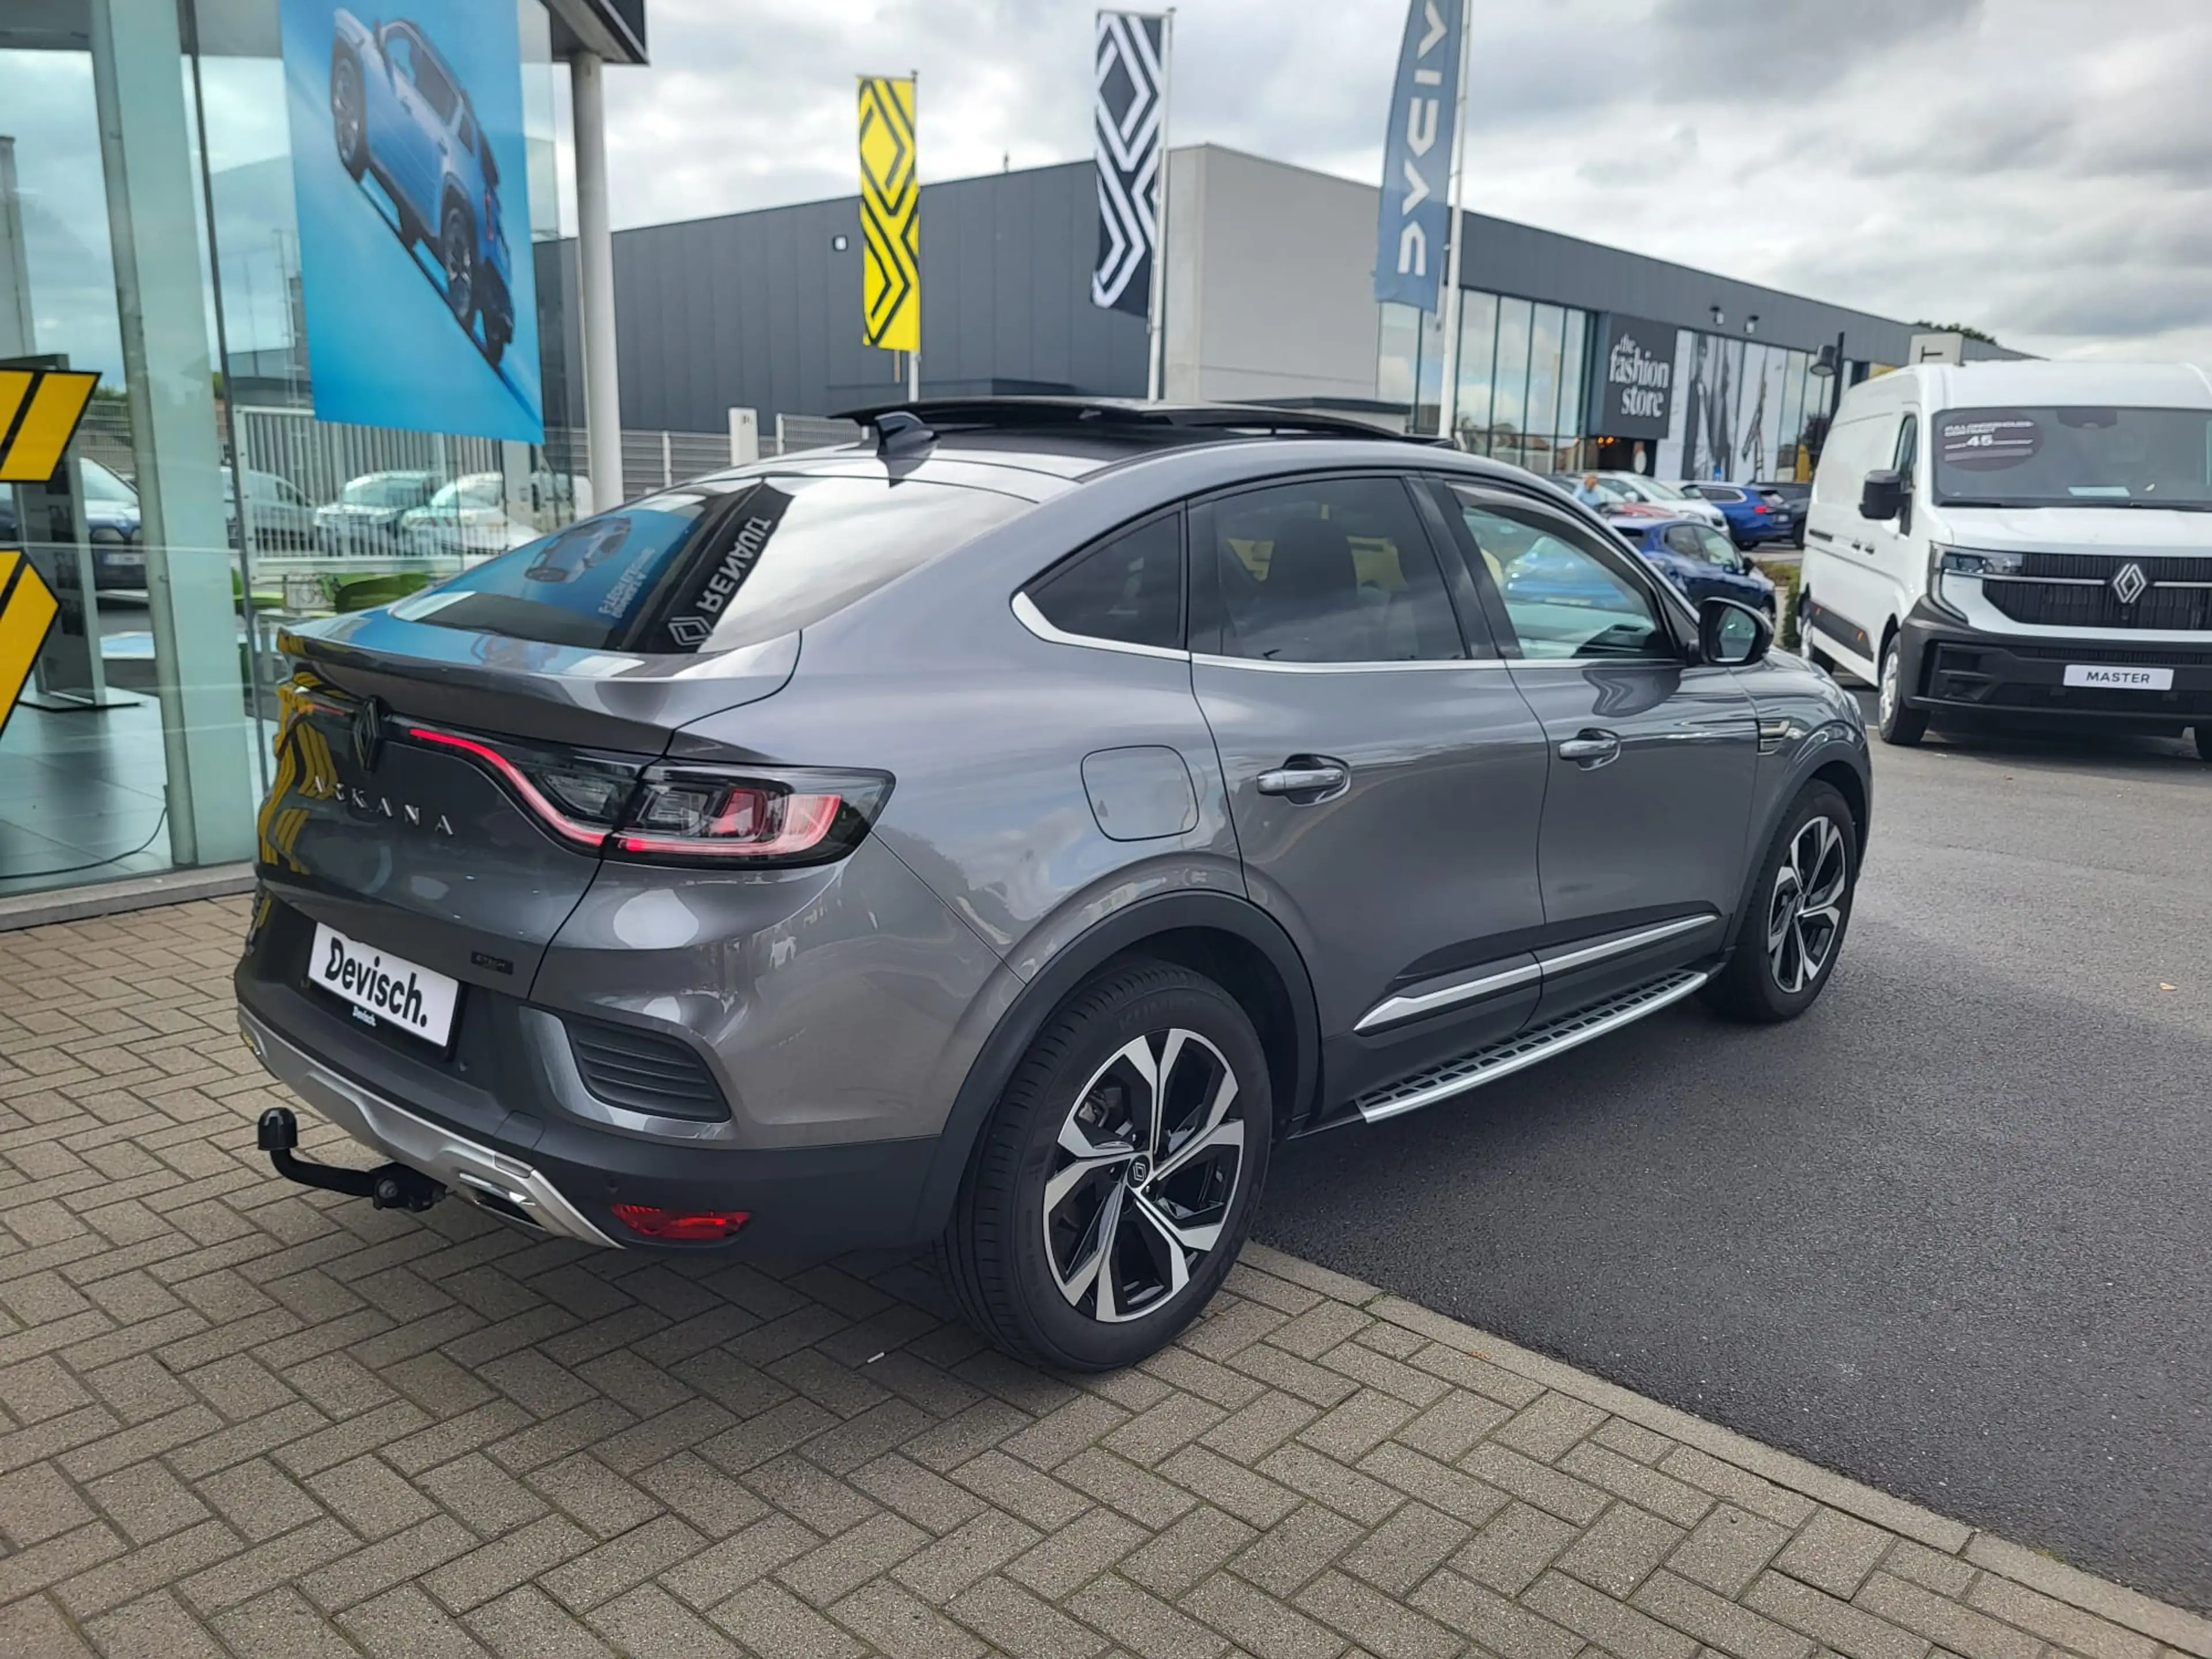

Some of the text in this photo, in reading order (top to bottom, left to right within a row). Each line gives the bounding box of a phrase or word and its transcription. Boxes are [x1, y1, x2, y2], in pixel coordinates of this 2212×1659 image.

[1620, 332, 1637, 354] the
[1609, 344, 1669, 388] fashion
[1620, 385, 1664, 417] store
[2086, 671, 2150, 684] MASTER
[324, 937, 427, 1028] Devisch.
